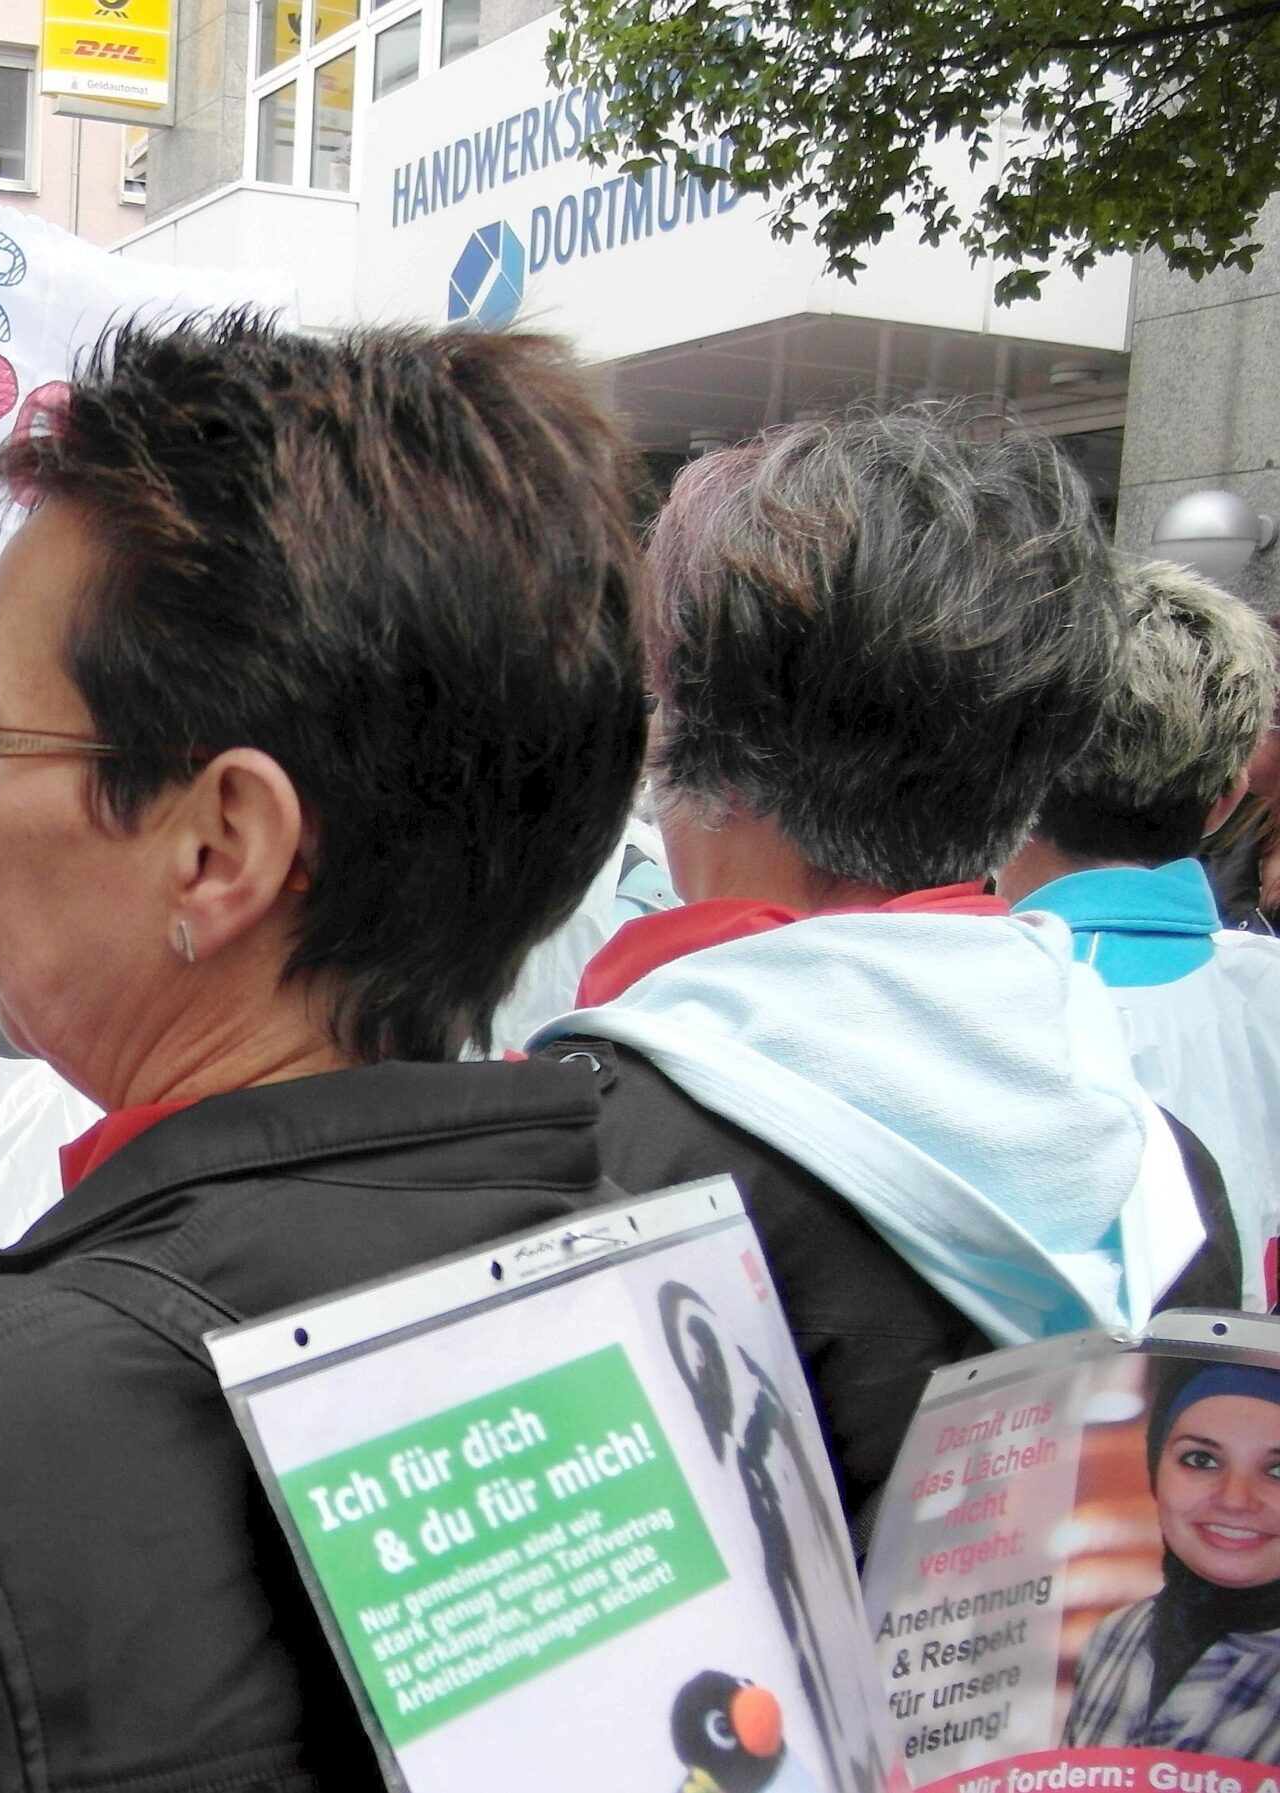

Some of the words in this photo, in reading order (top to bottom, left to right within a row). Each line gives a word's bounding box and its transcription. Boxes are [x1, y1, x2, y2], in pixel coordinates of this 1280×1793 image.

[74, 39, 144, 62] DHL
[87, 79, 148, 96] Geldautomat
[935, 1410, 1006, 1456] Damit
[1010, 1402, 1054, 1432] uns
[308, 1471, 388, 1532] Ich
[389, 1446, 452, 1498] für
[461, 1407, 548, 1469] dich
[374, 1527, 416, 1573] &
[419, 1506, 477, 1556] du
[475, 1478, 539, 1529] für
[545, 1421, 657, 1499] mich!
[911, 1469, 955, 1500] das
[961, 1437, 1057, 1486] Lächeln
[944, 1490, 1008, 1528] nicht
[358, 1601, 400, 1634] Nur
[404, 1548, 521, 1618] gemeinsam
[523, 1523, 568, 1560] sind
[567, 1509, 603, 1538] wir
[372, 1620, 428, 1662] stark
[429, 1591, 497, 1638] genug
[496, 1561, 554, 1601] einen
[554, 1508, 675, 1573] Tarifvertrag
[383, 1661, 412, 1688] zu
[530, 1584, 566, 1615] der
[569, 1567, 609, 1598] uns
[610, 1544, 658, 1582] gute
[875, 1575, 1053, 1643] Anerkennung
[394, 1601, 598, 1716] Arbeitsbedingungen
[892, 1649, 911, 1680] &
[920, 1617, 1027, 1672] Respekt
[888, 1689, 926, 1720] für
[932, 1665, 1021, 1710] unsere
[1007, 1762, 1134, 1793] fordern:
[1148, 1762, 1242, 1793] Gute
